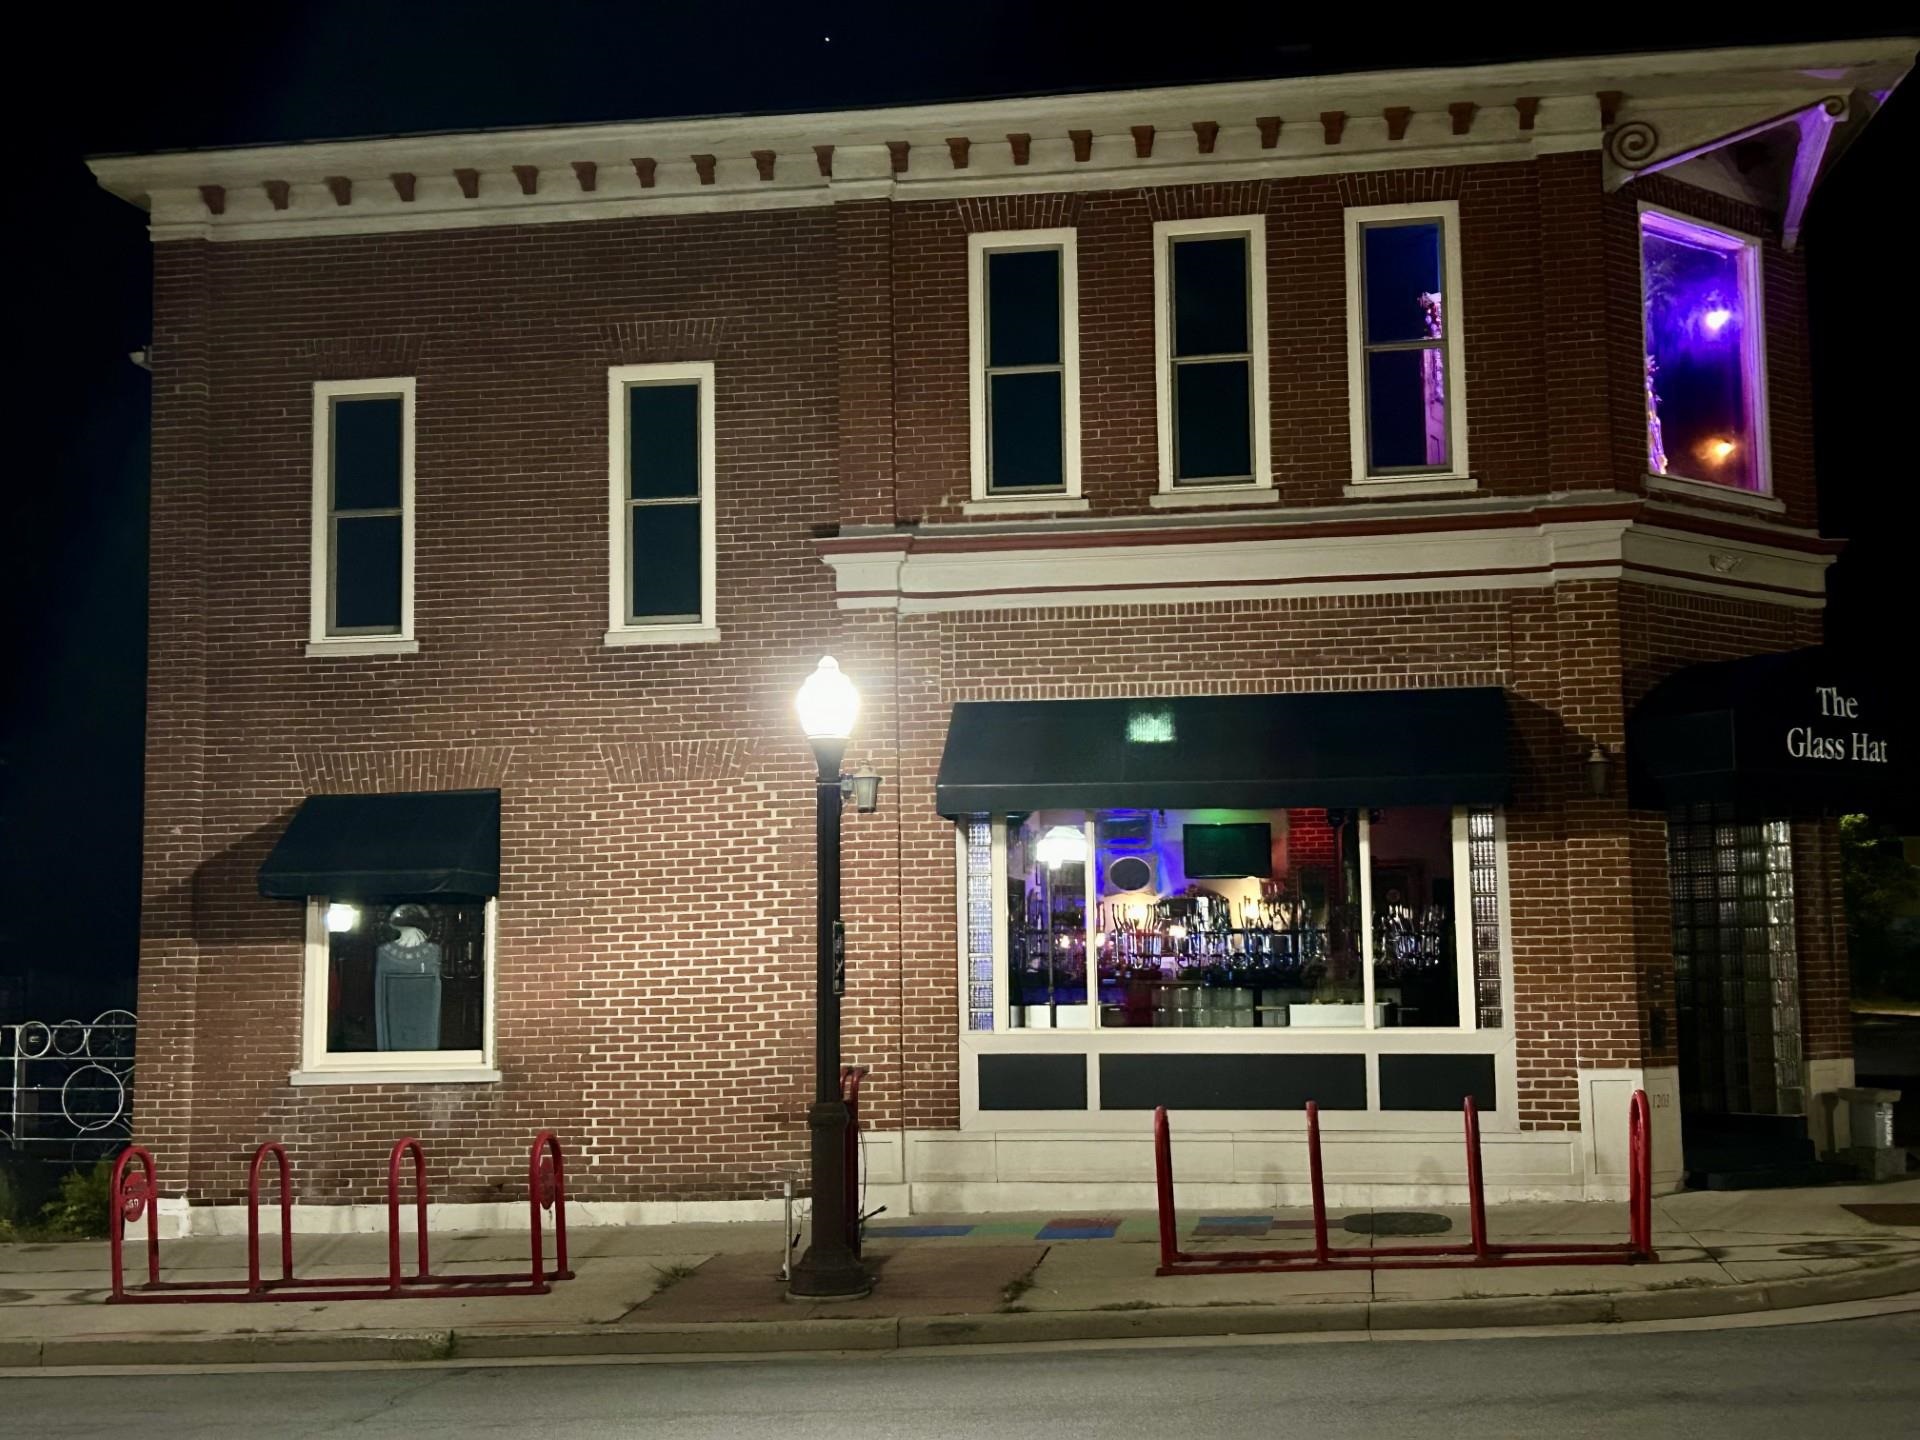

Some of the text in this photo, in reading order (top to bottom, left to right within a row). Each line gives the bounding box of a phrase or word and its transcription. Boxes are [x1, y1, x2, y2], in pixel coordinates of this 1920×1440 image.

[1816, 686, 1859, 719] The
[1786, 727, 1888, 763] Glass Hat
